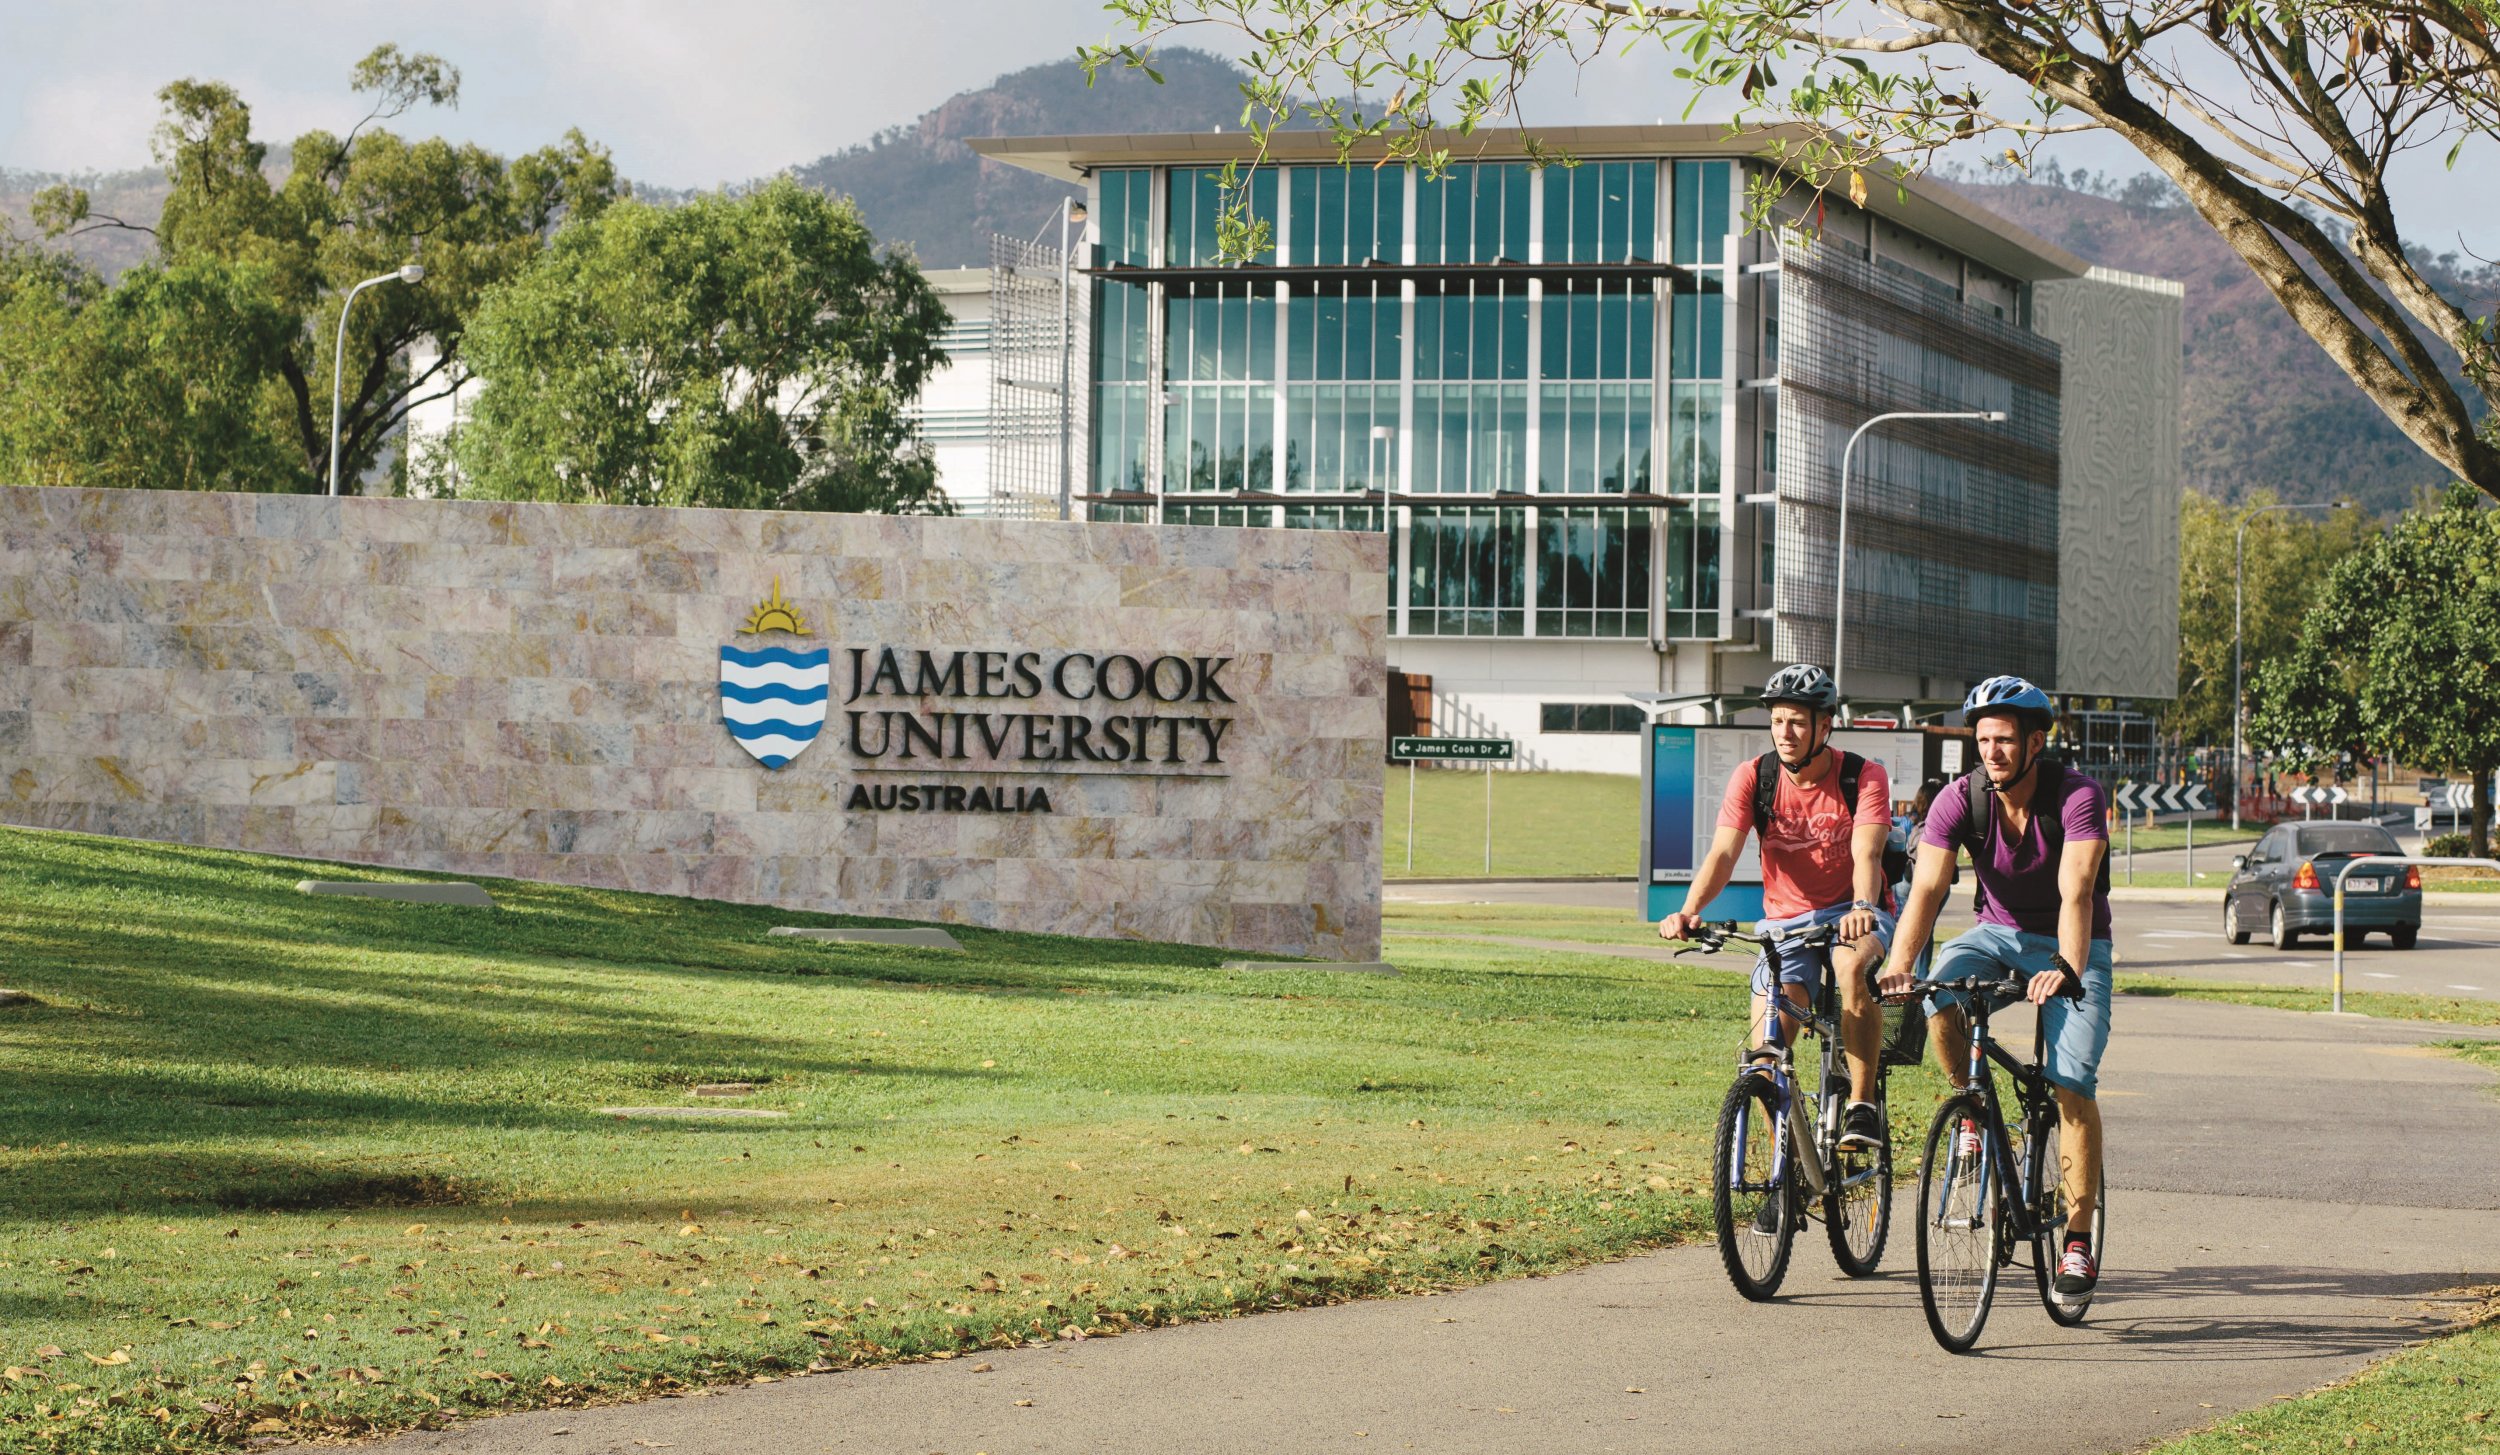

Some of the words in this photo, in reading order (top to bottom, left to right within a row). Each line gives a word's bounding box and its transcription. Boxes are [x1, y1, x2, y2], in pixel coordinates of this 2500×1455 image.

[844, 648, 1042, 704] JAMES
[1053, 654, 1237, 703] COOK
[845, 711, 1234, 763] UNIVERSITY
[1415, 744, 1446, 753] James
[1452, 744, 1475, 754] Cook
[1481, 745, 1492, 754] Dr
[847, 784, 1053, 812] AUSTRALIA
